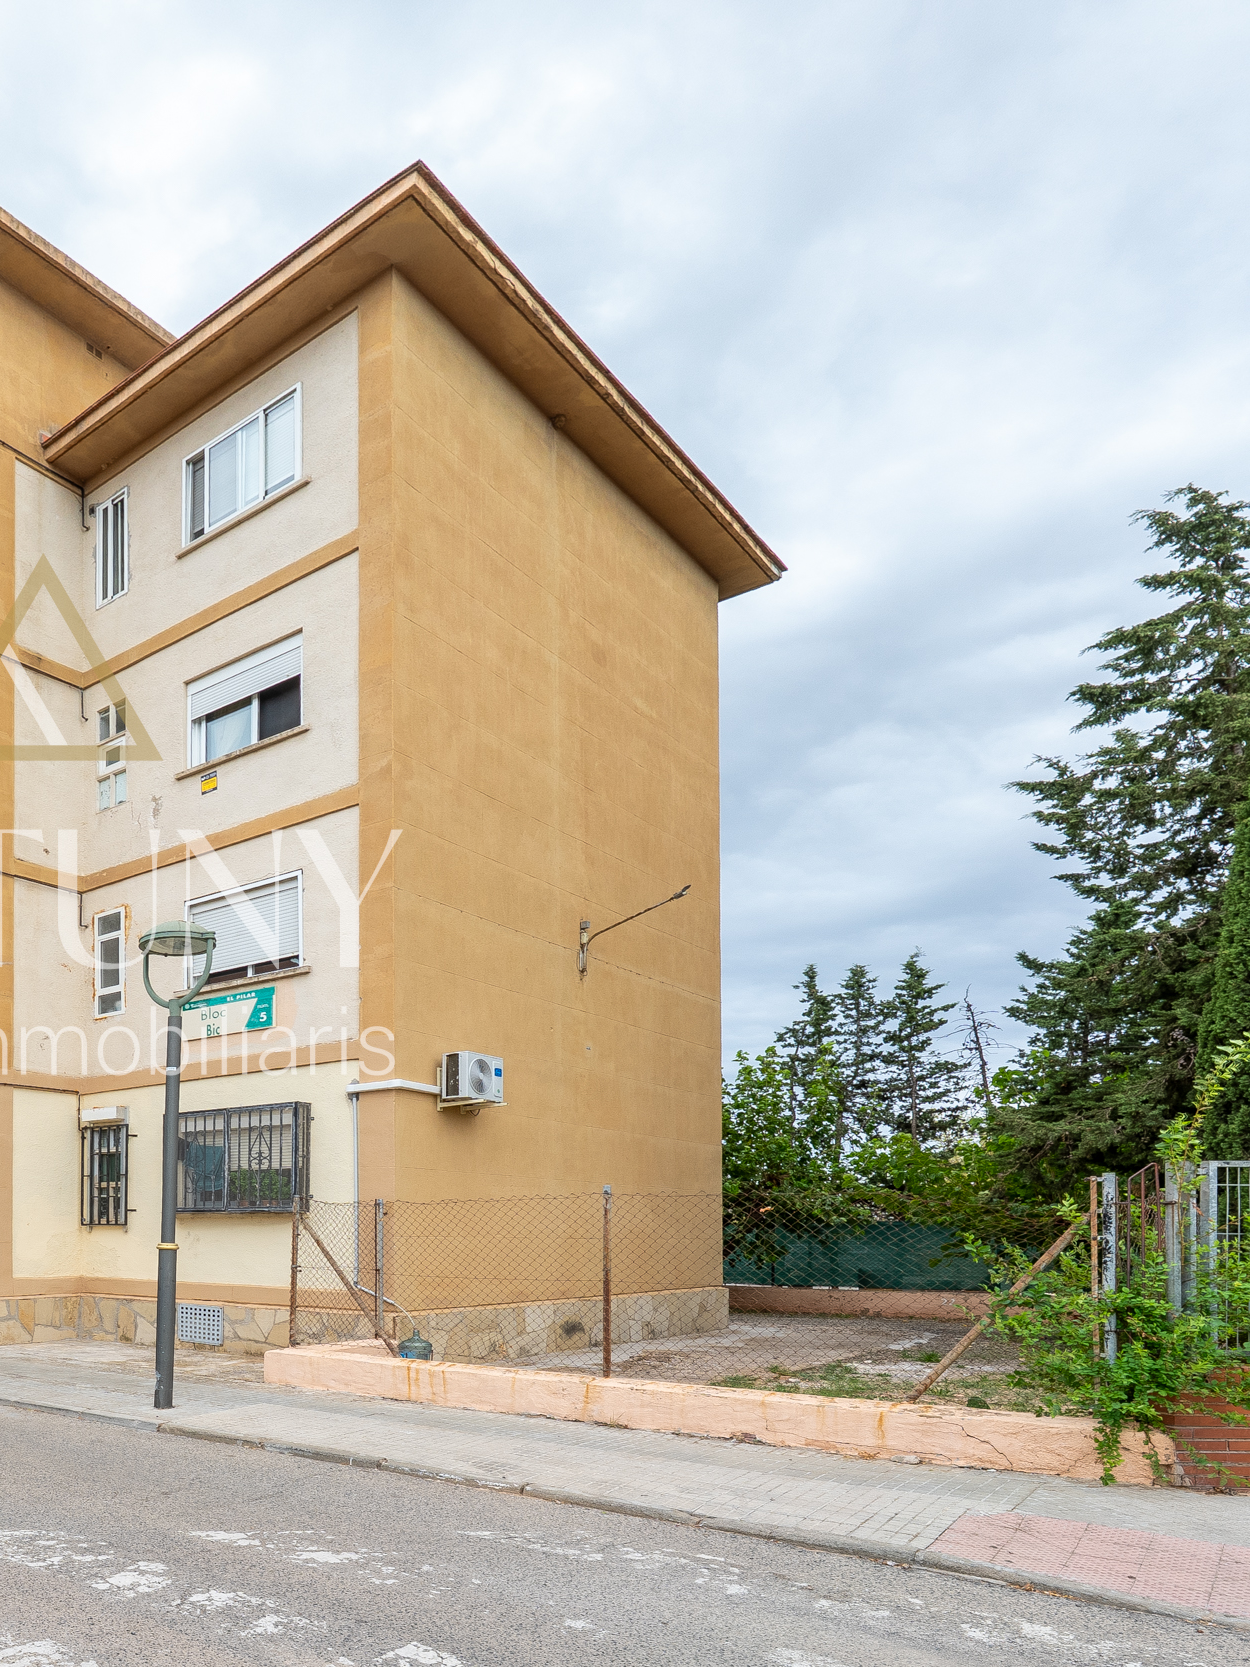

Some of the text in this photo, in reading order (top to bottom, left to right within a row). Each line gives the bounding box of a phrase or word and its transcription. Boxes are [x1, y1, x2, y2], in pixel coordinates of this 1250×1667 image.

[236, 992, 256, 1000] PILAR
[201, 1008, 226, 1021] Bloc
[259, 1011, 267, 1022] 5
[206, 1023, 220, 1037] Bic
